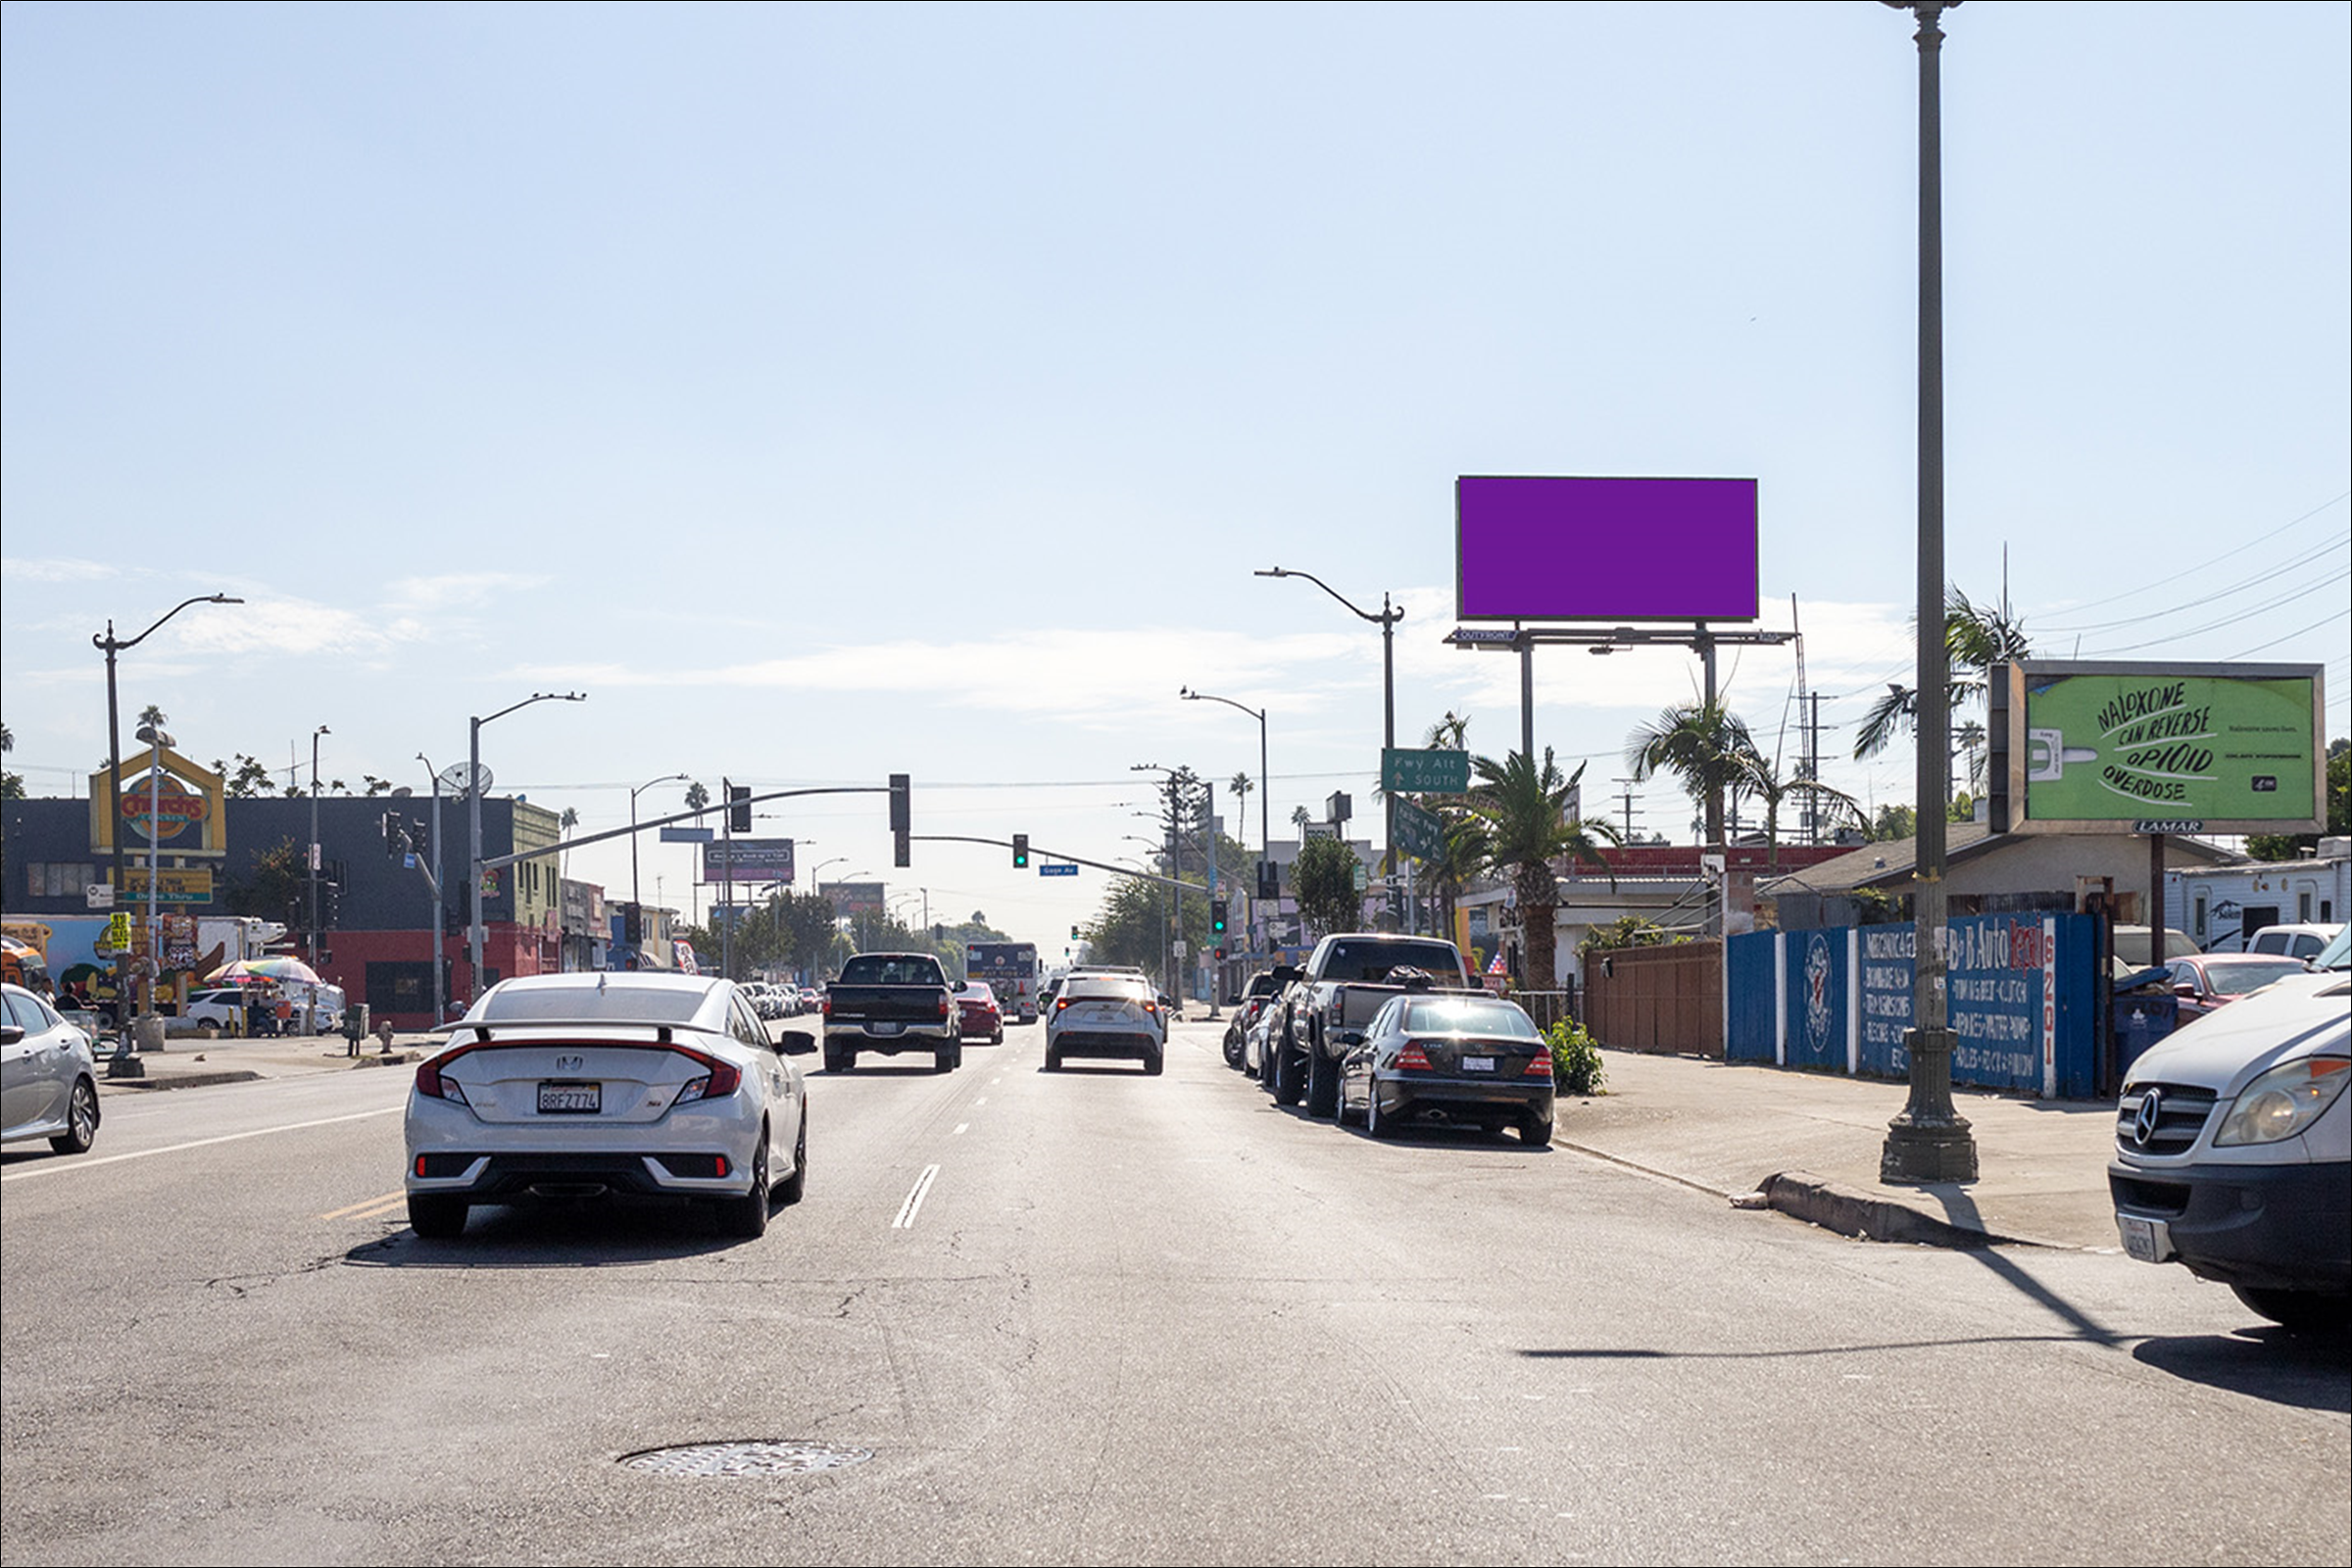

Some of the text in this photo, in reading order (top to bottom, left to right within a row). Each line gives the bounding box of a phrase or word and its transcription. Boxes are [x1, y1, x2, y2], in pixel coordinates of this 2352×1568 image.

[2097, 682, 2185, 732] NALOXONE
[2118, 707, 2211, 746] CAN REVERSE
[1395, 758, 1455, 769] Fwy Alt
[1415, 774, 1458, 786] SOUTH
[2102, 765, 2185, 800] OVERDOSE
[2138, 821, 2200, 831] LAMAR
[1975, 918, 2009, 969] Auto
[541, 1093, 596, 1108] 8RFZ774
